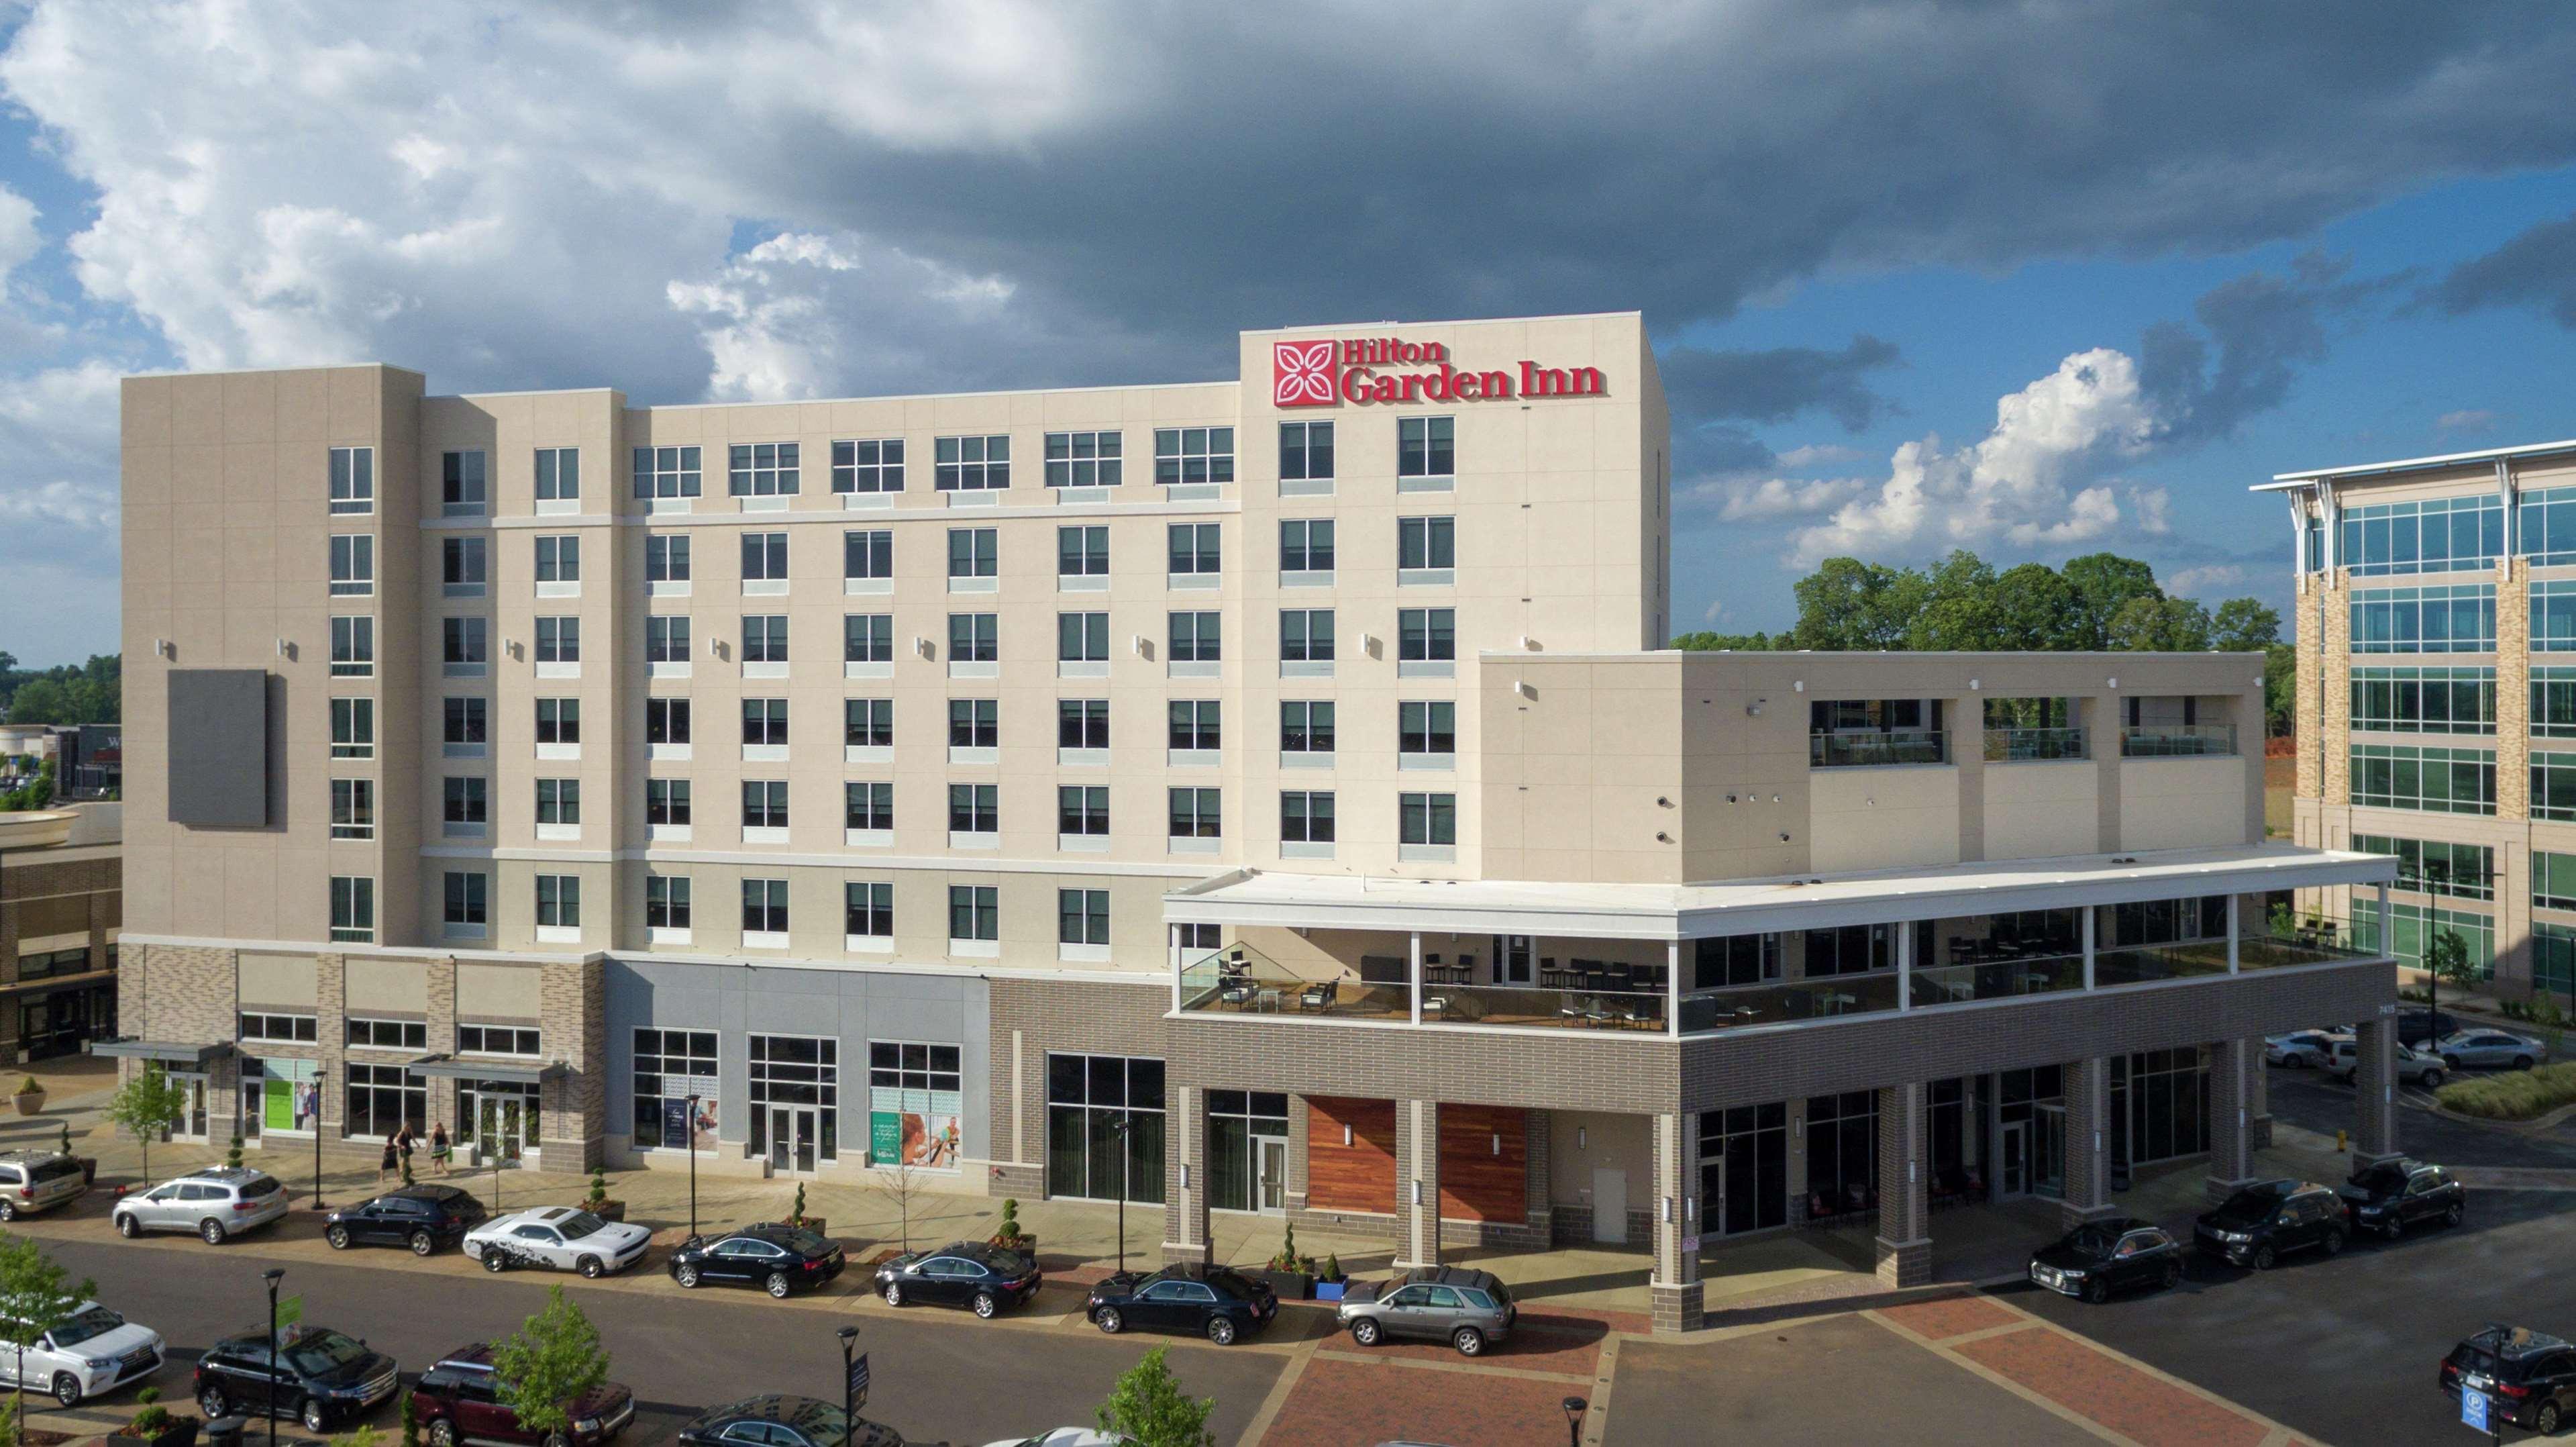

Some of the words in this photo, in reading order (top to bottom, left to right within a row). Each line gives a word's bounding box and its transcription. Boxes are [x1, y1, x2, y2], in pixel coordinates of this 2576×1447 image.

[1341, 337, 1445, 364] Hilton
[1341, 363, 1510, 403] Garden
[1517, 360, 1603, 396] Inn
